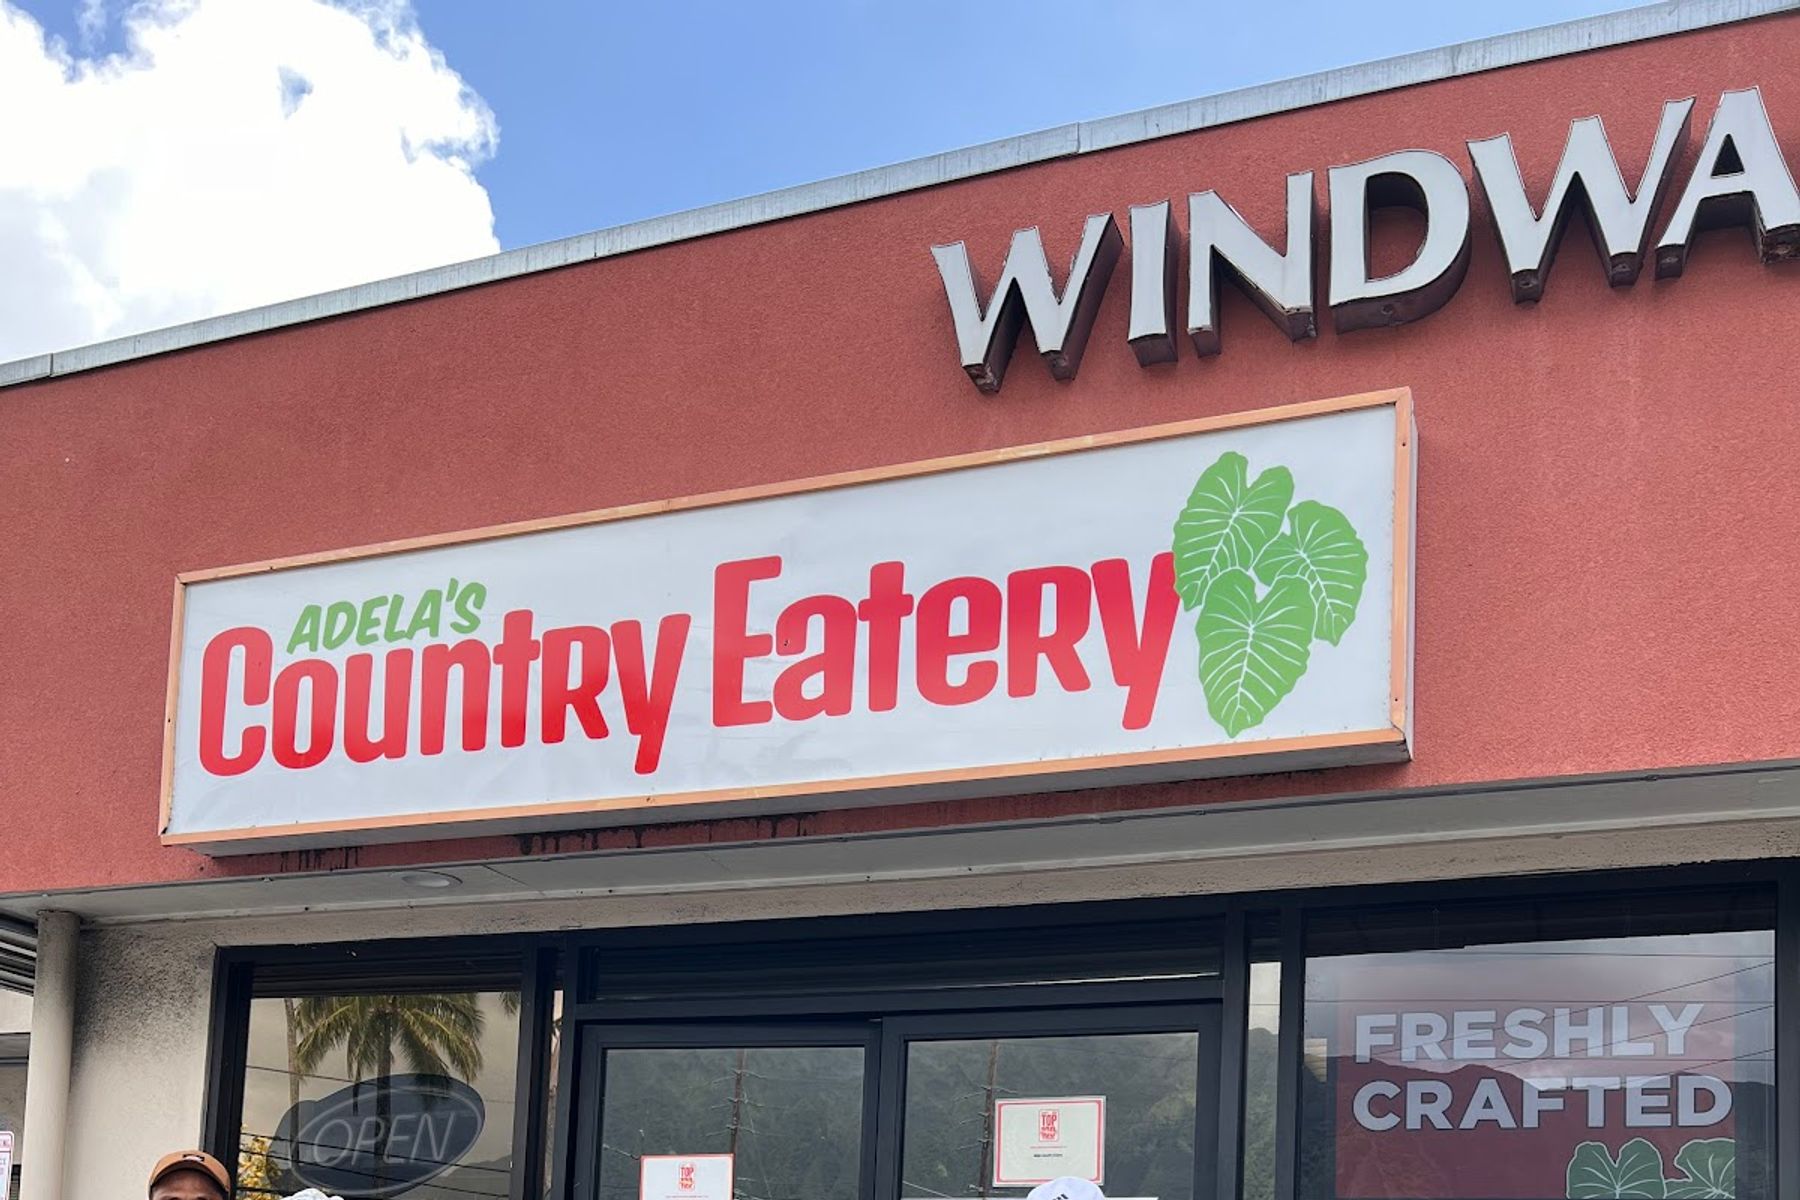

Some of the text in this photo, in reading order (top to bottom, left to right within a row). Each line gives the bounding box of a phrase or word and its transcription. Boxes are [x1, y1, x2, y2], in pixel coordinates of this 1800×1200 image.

[930, 85, 1800, 370] WINDWA
[286, 578, 487, 654] ADELA'S
[1355, 1003, 1703, 1063] FRESHLY
[1353, 1074, 1732, 1131] CRAFTED
[313, 1112, 456, 1166] OPEN
